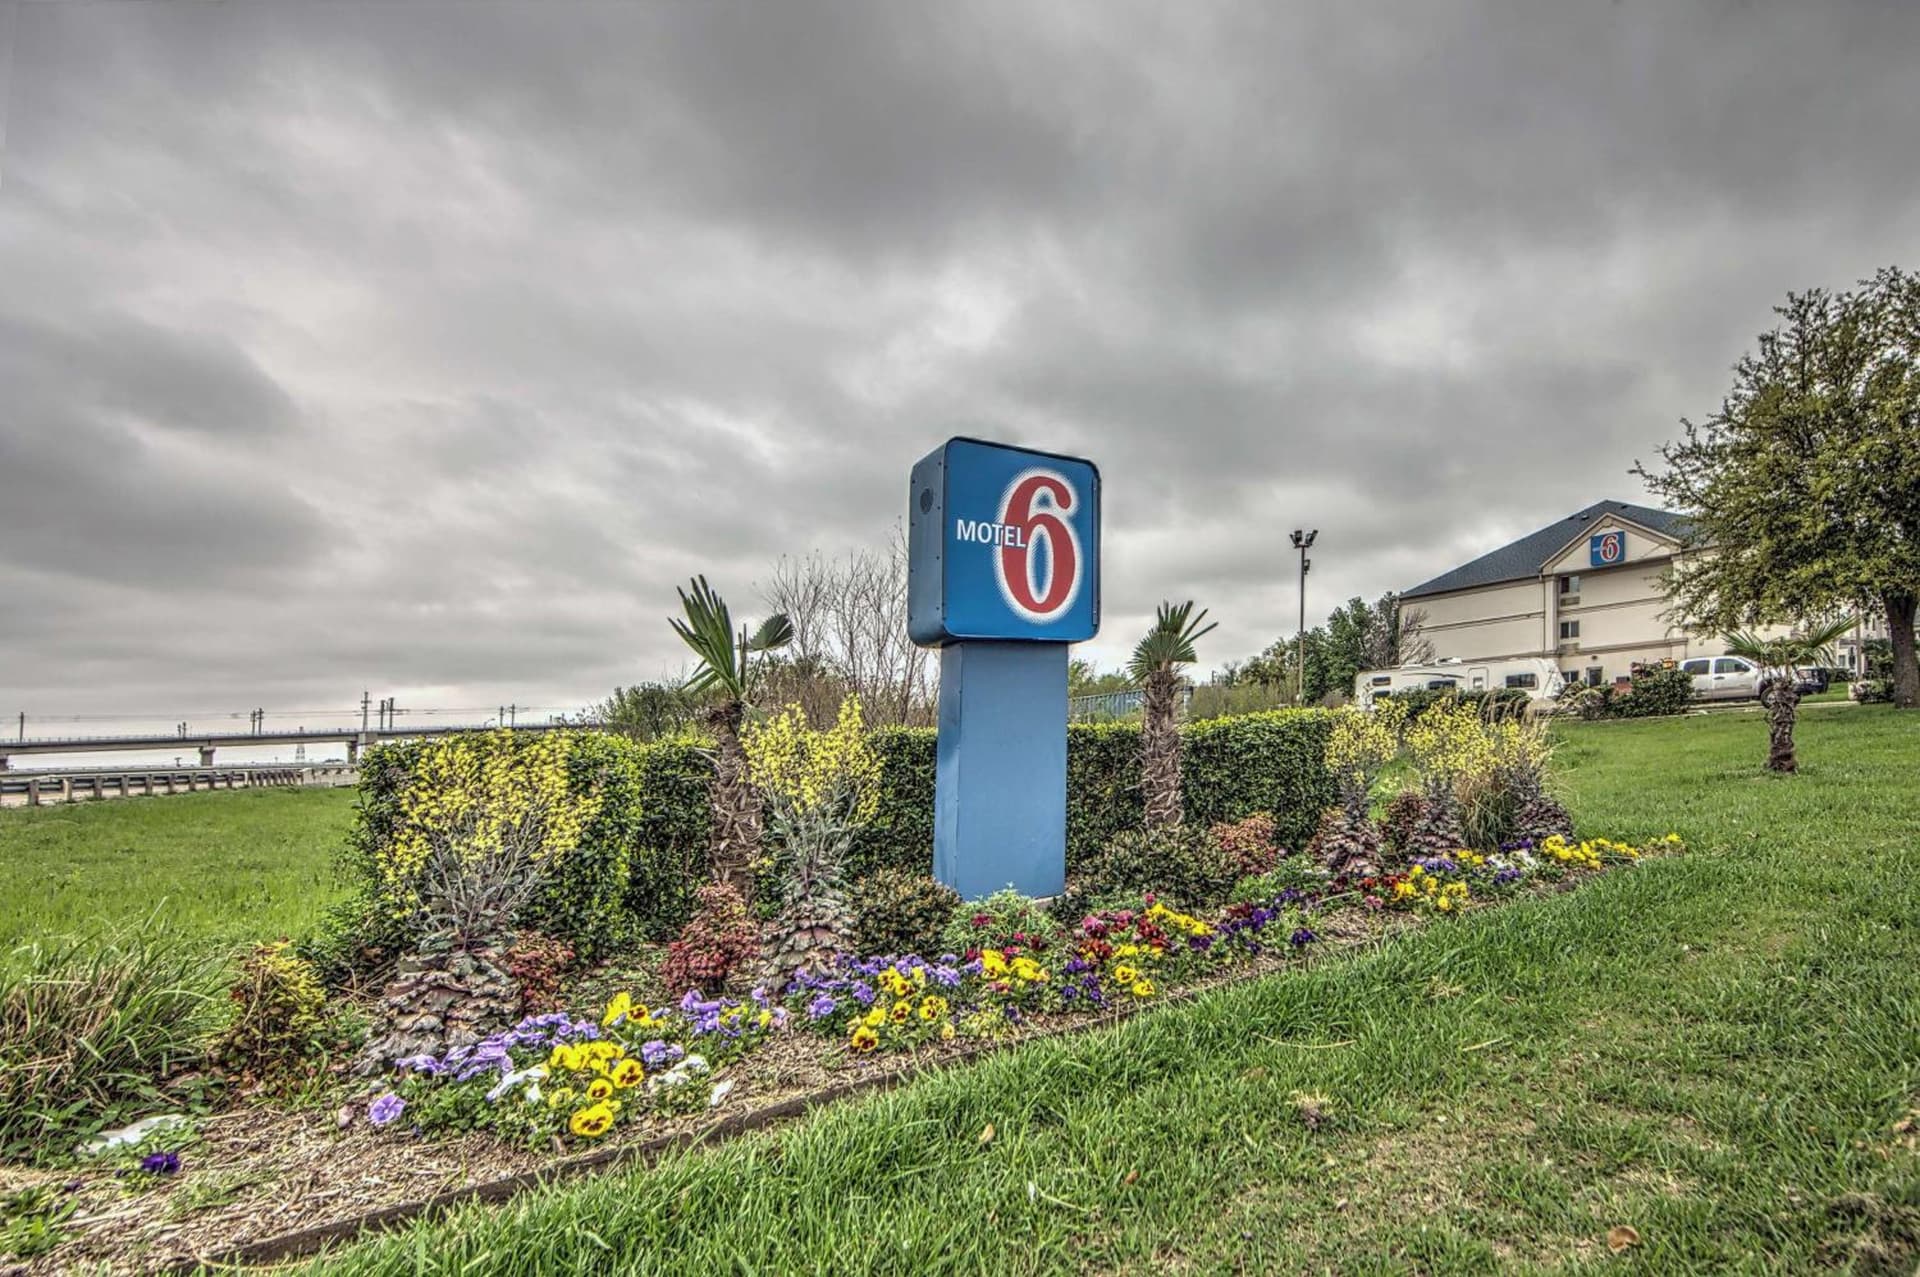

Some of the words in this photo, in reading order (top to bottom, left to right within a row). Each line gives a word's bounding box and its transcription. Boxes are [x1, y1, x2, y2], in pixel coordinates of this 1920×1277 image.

[956, 519, 1027, 548] MOTEL
[1001, 474, 1077, 614] 6
[1600, 534, 1619, 561] 6
